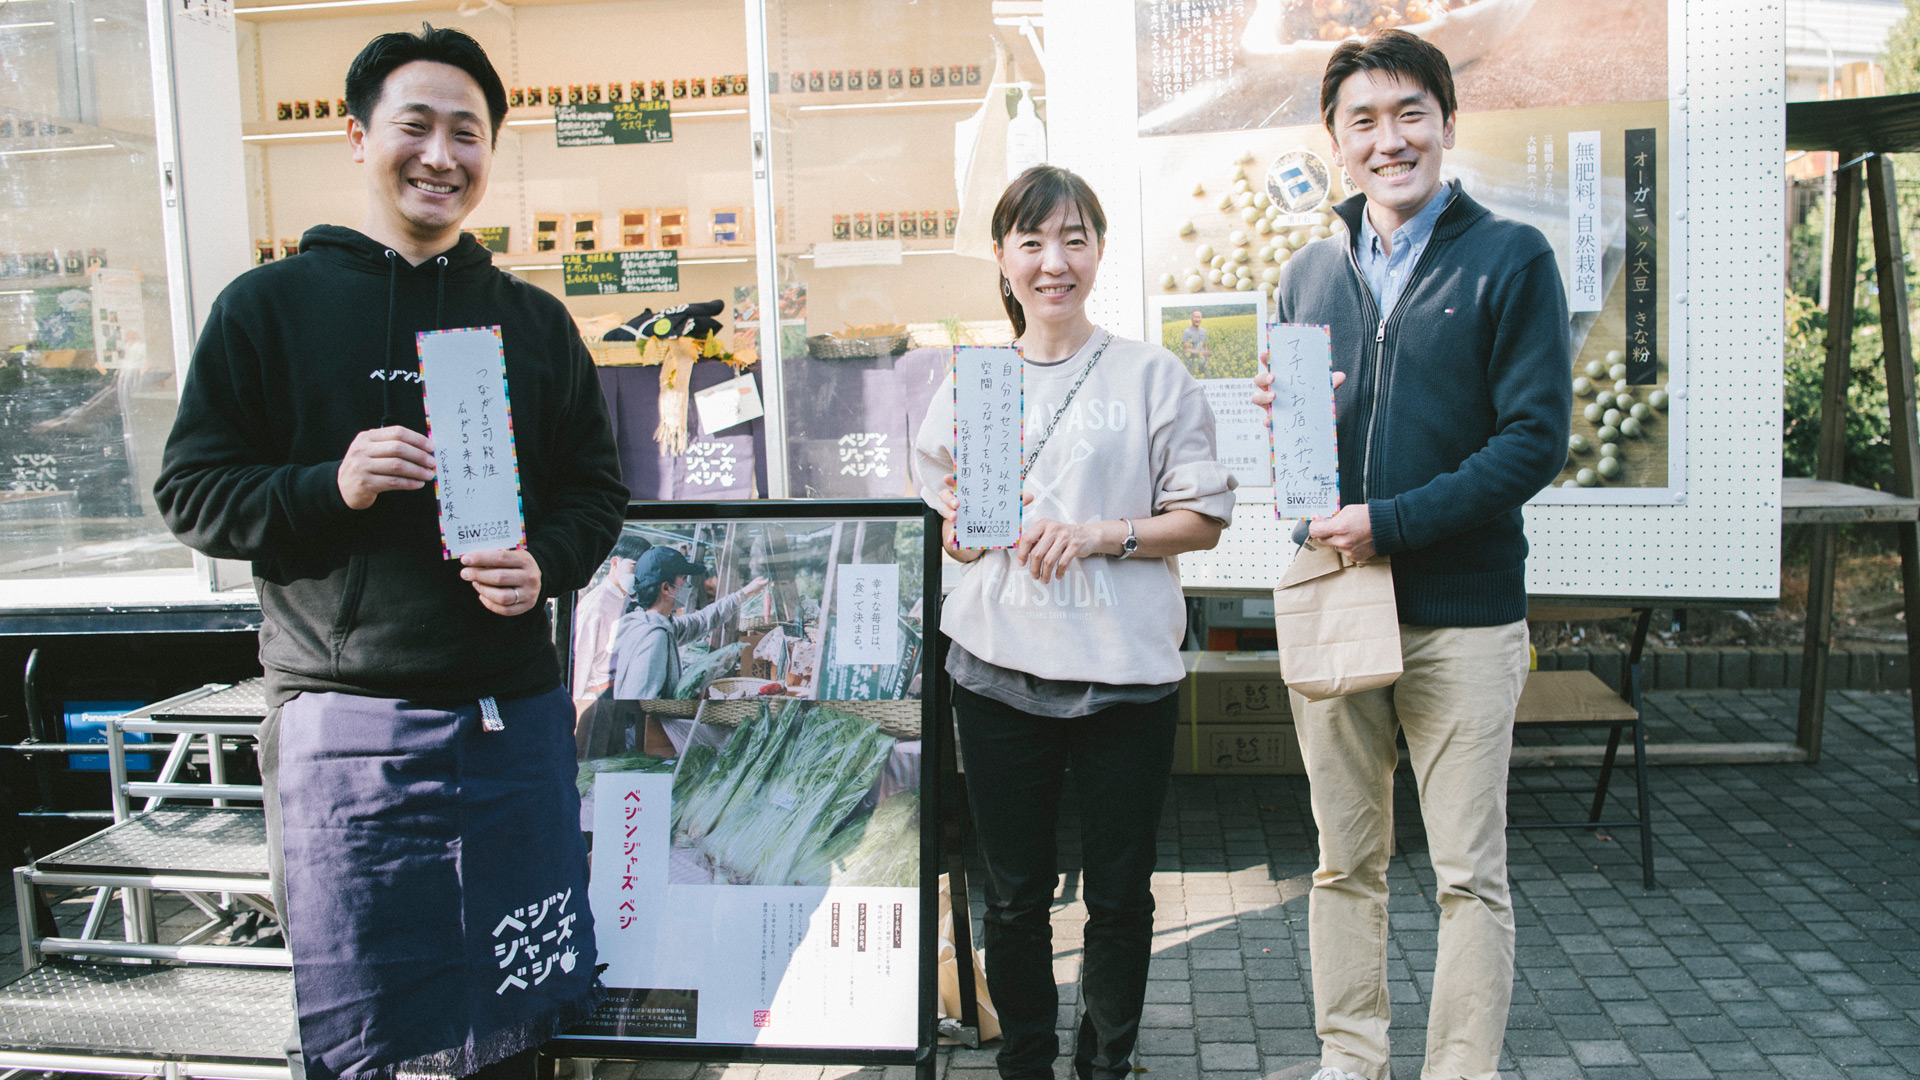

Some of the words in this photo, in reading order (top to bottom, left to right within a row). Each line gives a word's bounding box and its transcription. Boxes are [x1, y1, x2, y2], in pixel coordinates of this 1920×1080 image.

[1574, 142, 1597, 303] 無肥料。自然栽培。
[1632, 151, 1651, 364] オーガニック大豆・きな粉
[686, 442, 734, 457] ベジン
[838, 433, 888, 447] ベジン
[839, 447, 890, 462] ジャーズ
[685, 471, 721, 486] ベジ
[686, 456, 736, 472] ジャーズ
[840, 462, 876, 477] ベジ
[853, 577, 865, 651] 「食」で決まる。
[871, 578, 882, 650] 幸せな毎日は、
[621, 789, 642, 891] ベジンジャーズ
[492, 887, 572, 938] ベジン
[618, 899, 638, 930] ベジ
[494, 912, 576, 970] ジャーズ
[496, 951, 560, 996] ベジ
